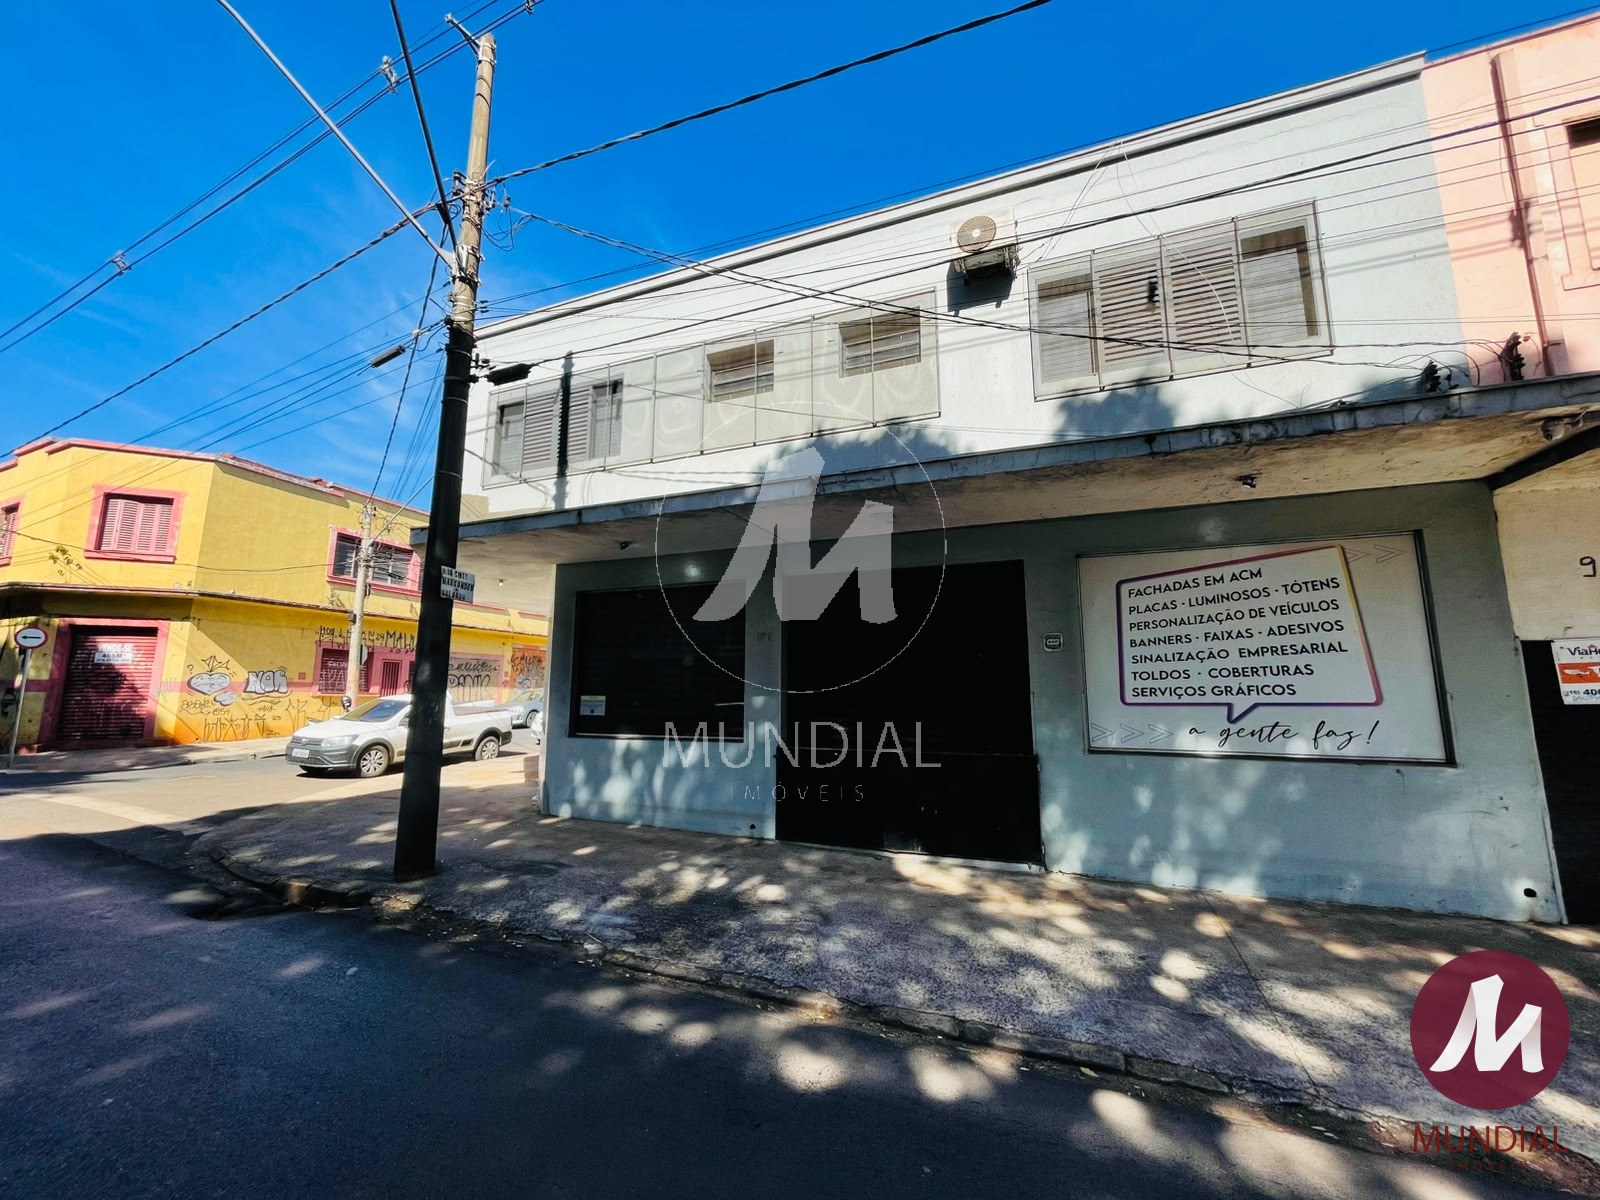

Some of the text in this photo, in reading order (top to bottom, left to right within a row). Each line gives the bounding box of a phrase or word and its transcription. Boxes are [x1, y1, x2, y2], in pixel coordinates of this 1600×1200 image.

[1128, 568, 1263, 598] FACHADAS EM ACM
[1129, 577, 1341, 615] PLACAS LUMINOSOS TÓTENS
[1129, 599, 1340, 631] PERSONALIZAÇÃO DE VEÍCULOS
[1130, 619, 1345, 648] BANNERS FAIXAS ADESIVOS
[1131, 641, 1349, 664] SINALIZAÇÃO EMPRESARIAL
[1131, 663, 1314, 681] TOLDOS COBERTURAS
[1132, 682, 1297, 700] SERVIÇOS GRÁFICOS
[1583, 688, 1600, 696] 40
[1189, 727, 1205, 735] a
[1219, 721, 1299, 748] gente
